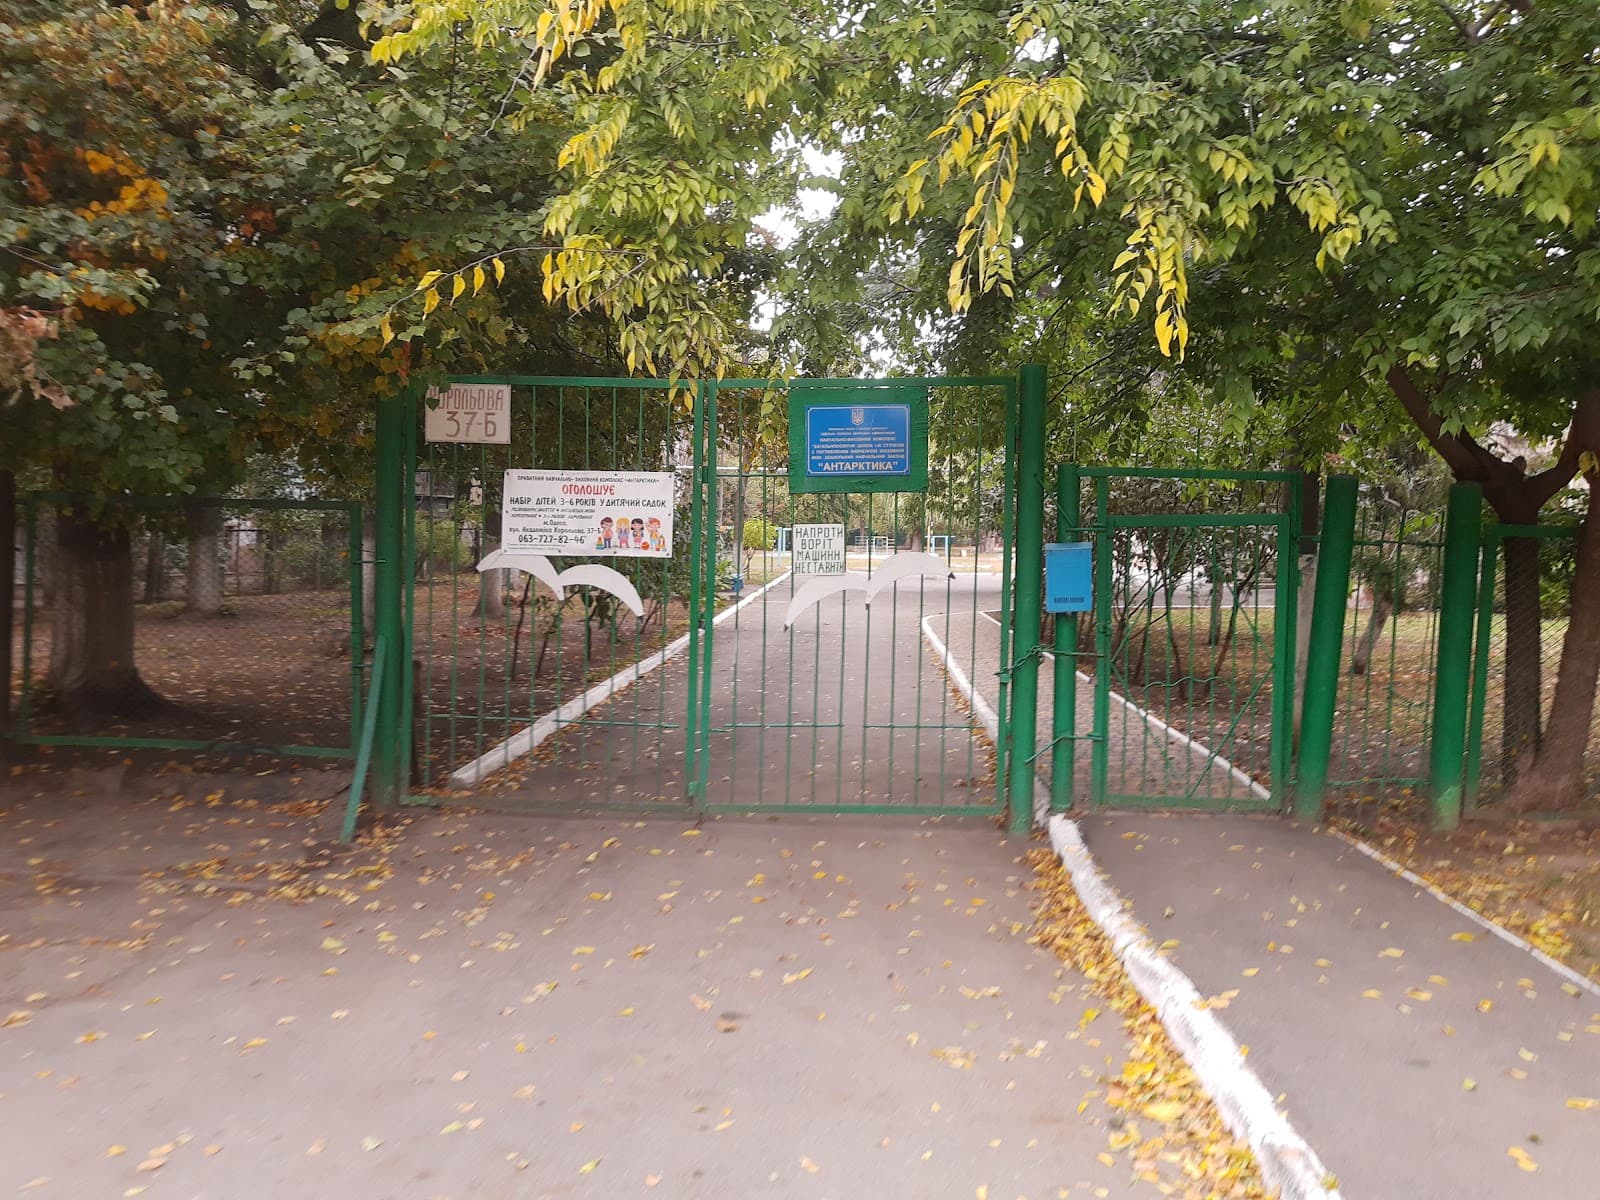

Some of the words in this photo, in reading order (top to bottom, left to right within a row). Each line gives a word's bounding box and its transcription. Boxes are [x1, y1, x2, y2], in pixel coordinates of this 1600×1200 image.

[445, 411, 497, 437] 37-Б
[562, 484, 615, 495] ОГОЛОШУЄ
[509, 496, 532, 505] НАБІР
[535, 496, 556, 505] ДІТЕЙ
[560, 497, 574, 506] 3-6
[575, 498, 596, 506] РОКІВ
[599, 498, 605, 506] У
[605, 498, 640, 507] ДИТЯЧИЙ
[642, 499, 666, 508] САДОК
[795, 527, 843, 538] НАПРОТИ
[518, 534, 585, 544] 063-727-82-46
[801, 538, 833, 550] ВОРІТ
[797, 550, 840, 561] МАШИНИ
